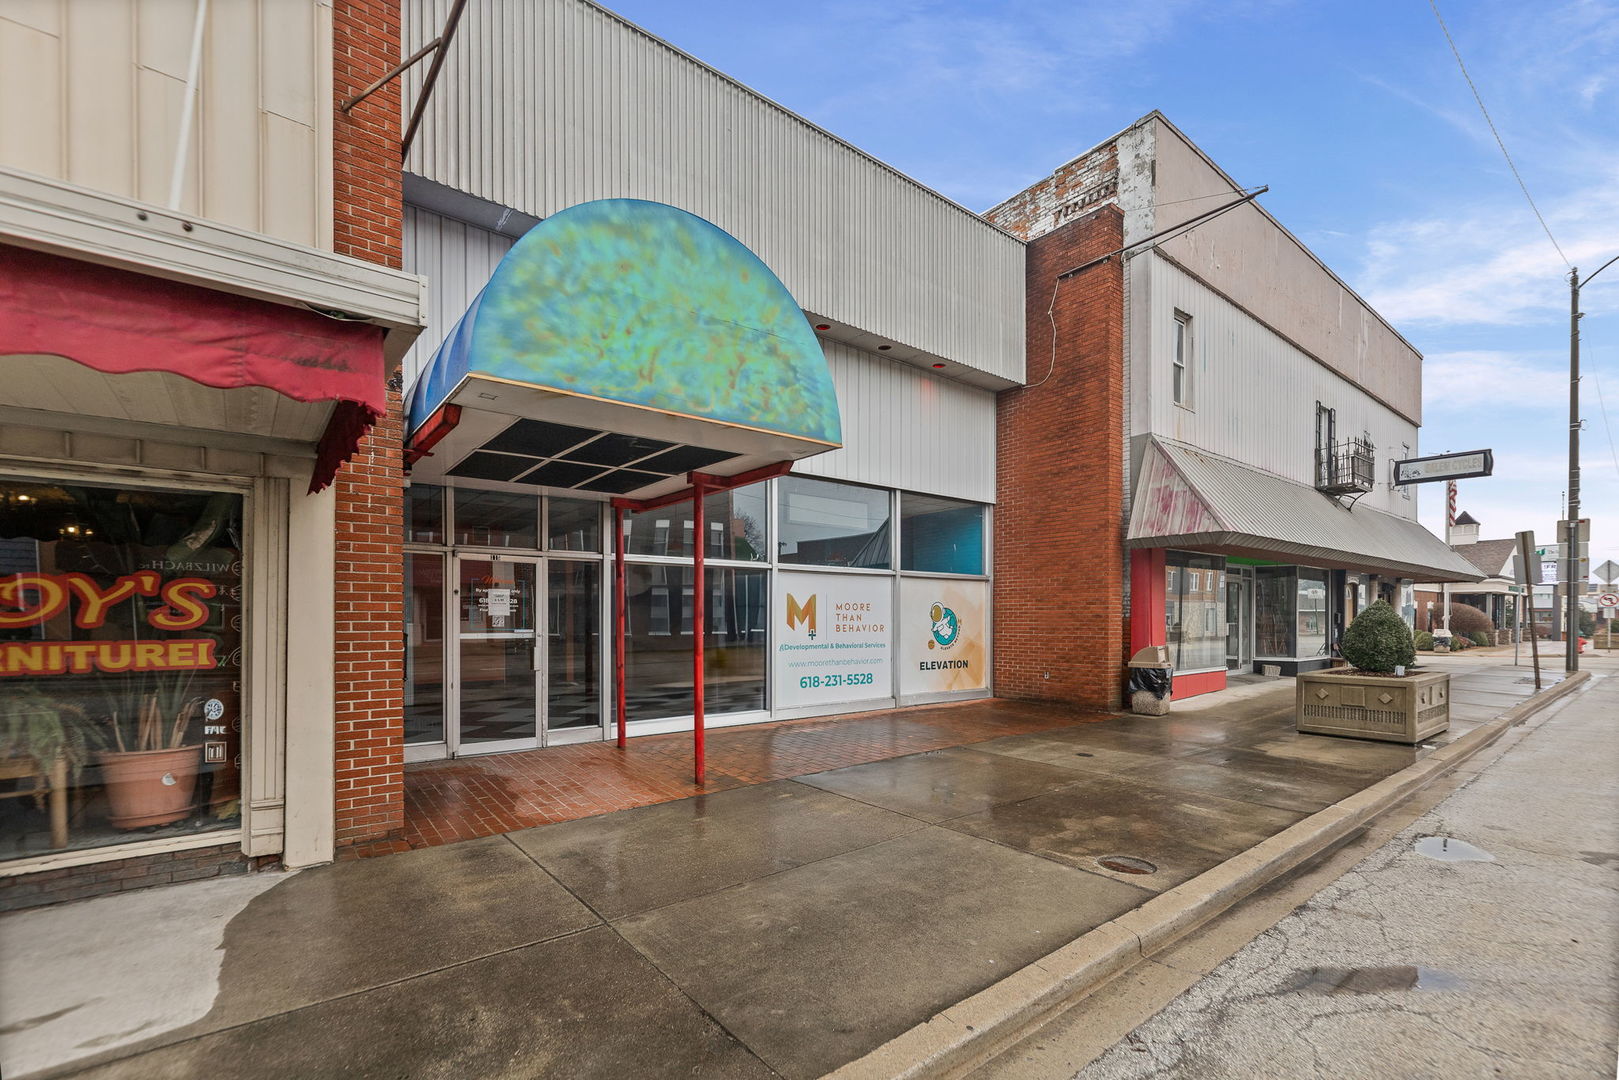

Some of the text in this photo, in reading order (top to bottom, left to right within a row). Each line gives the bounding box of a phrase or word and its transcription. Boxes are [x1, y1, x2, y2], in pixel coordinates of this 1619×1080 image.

[835, 603, 871, 611] MOORE
[835, 613, 863, 622] THAN
[835, 624, 885, 633] BEHAVIOR
[788, 657, 883, 668] www.moorethanbehavior.com
[919, 660, 969, 671] ELEVATION
[799, 673, 873, 688] 618-231-5528
